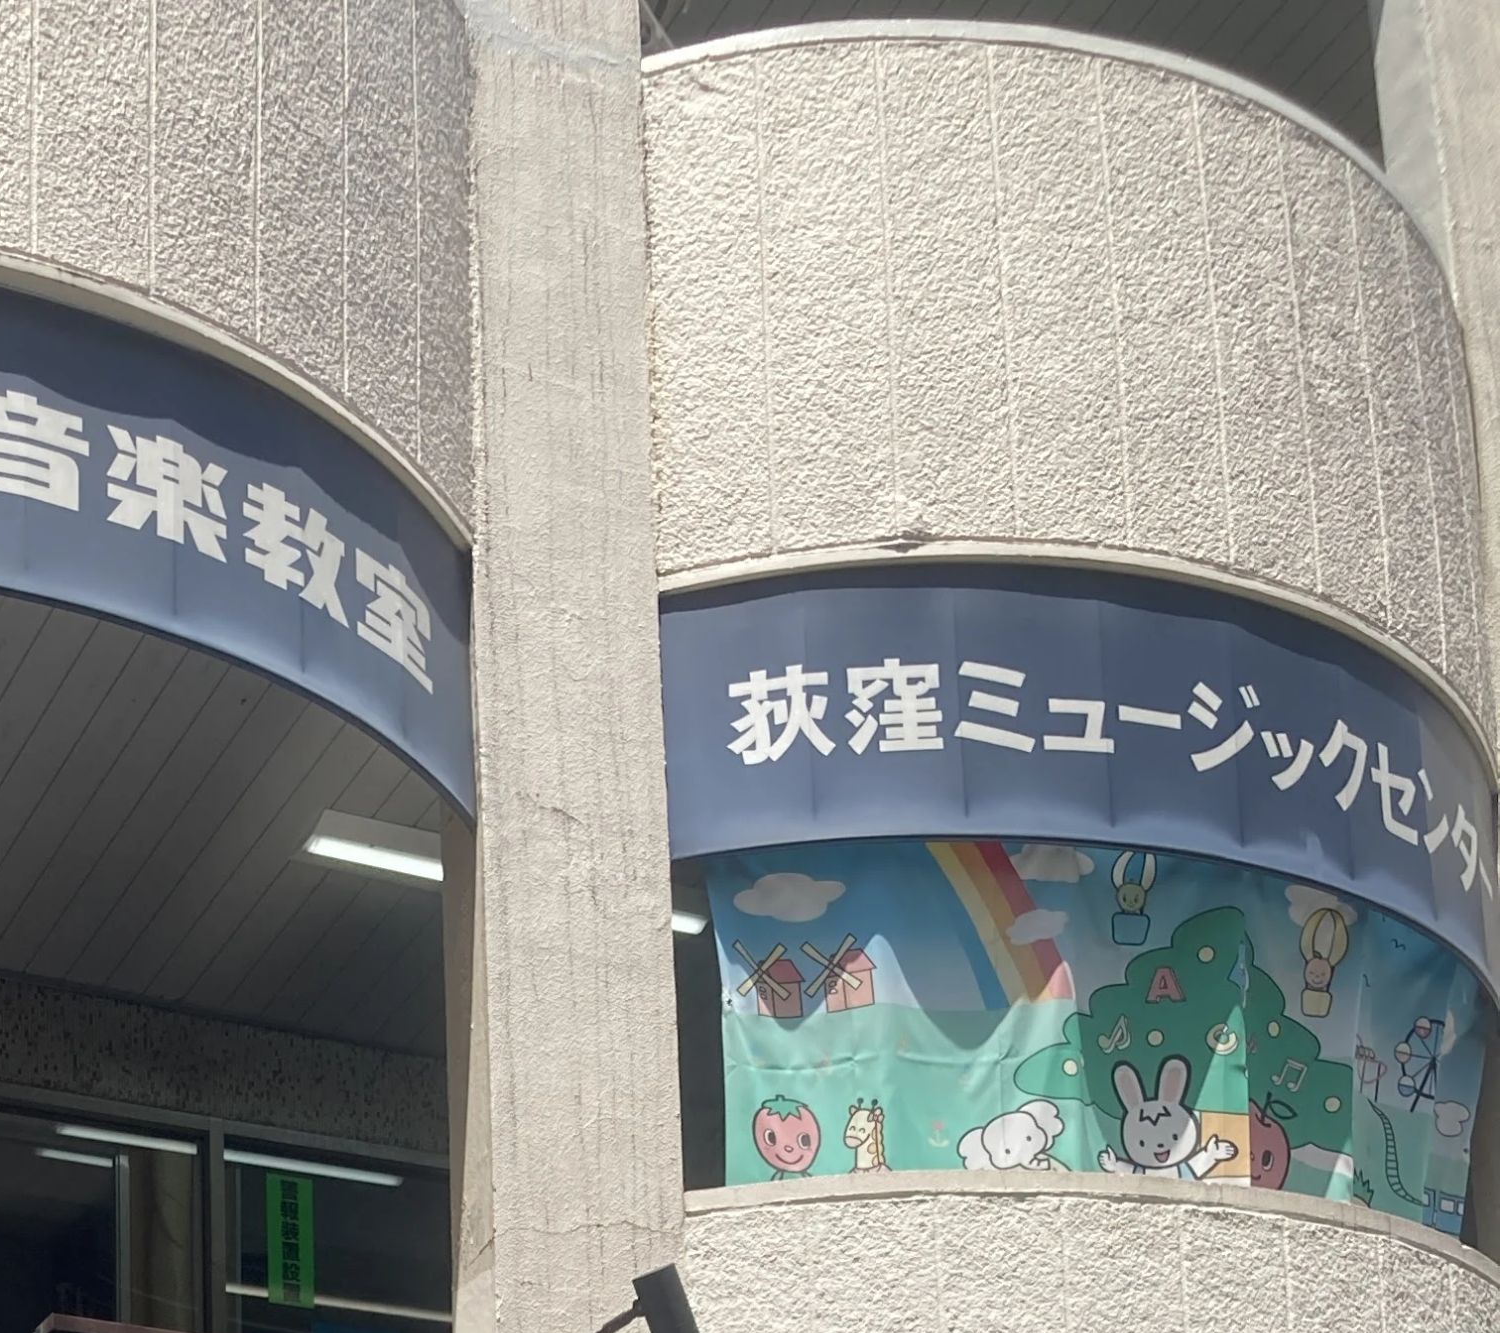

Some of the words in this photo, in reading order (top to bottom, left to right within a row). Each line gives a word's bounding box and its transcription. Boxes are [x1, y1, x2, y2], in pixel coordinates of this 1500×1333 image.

[728, 658, 1493, 899] 荻窪ミュージックセンター
[1145, 966, 1186, 1004] A
